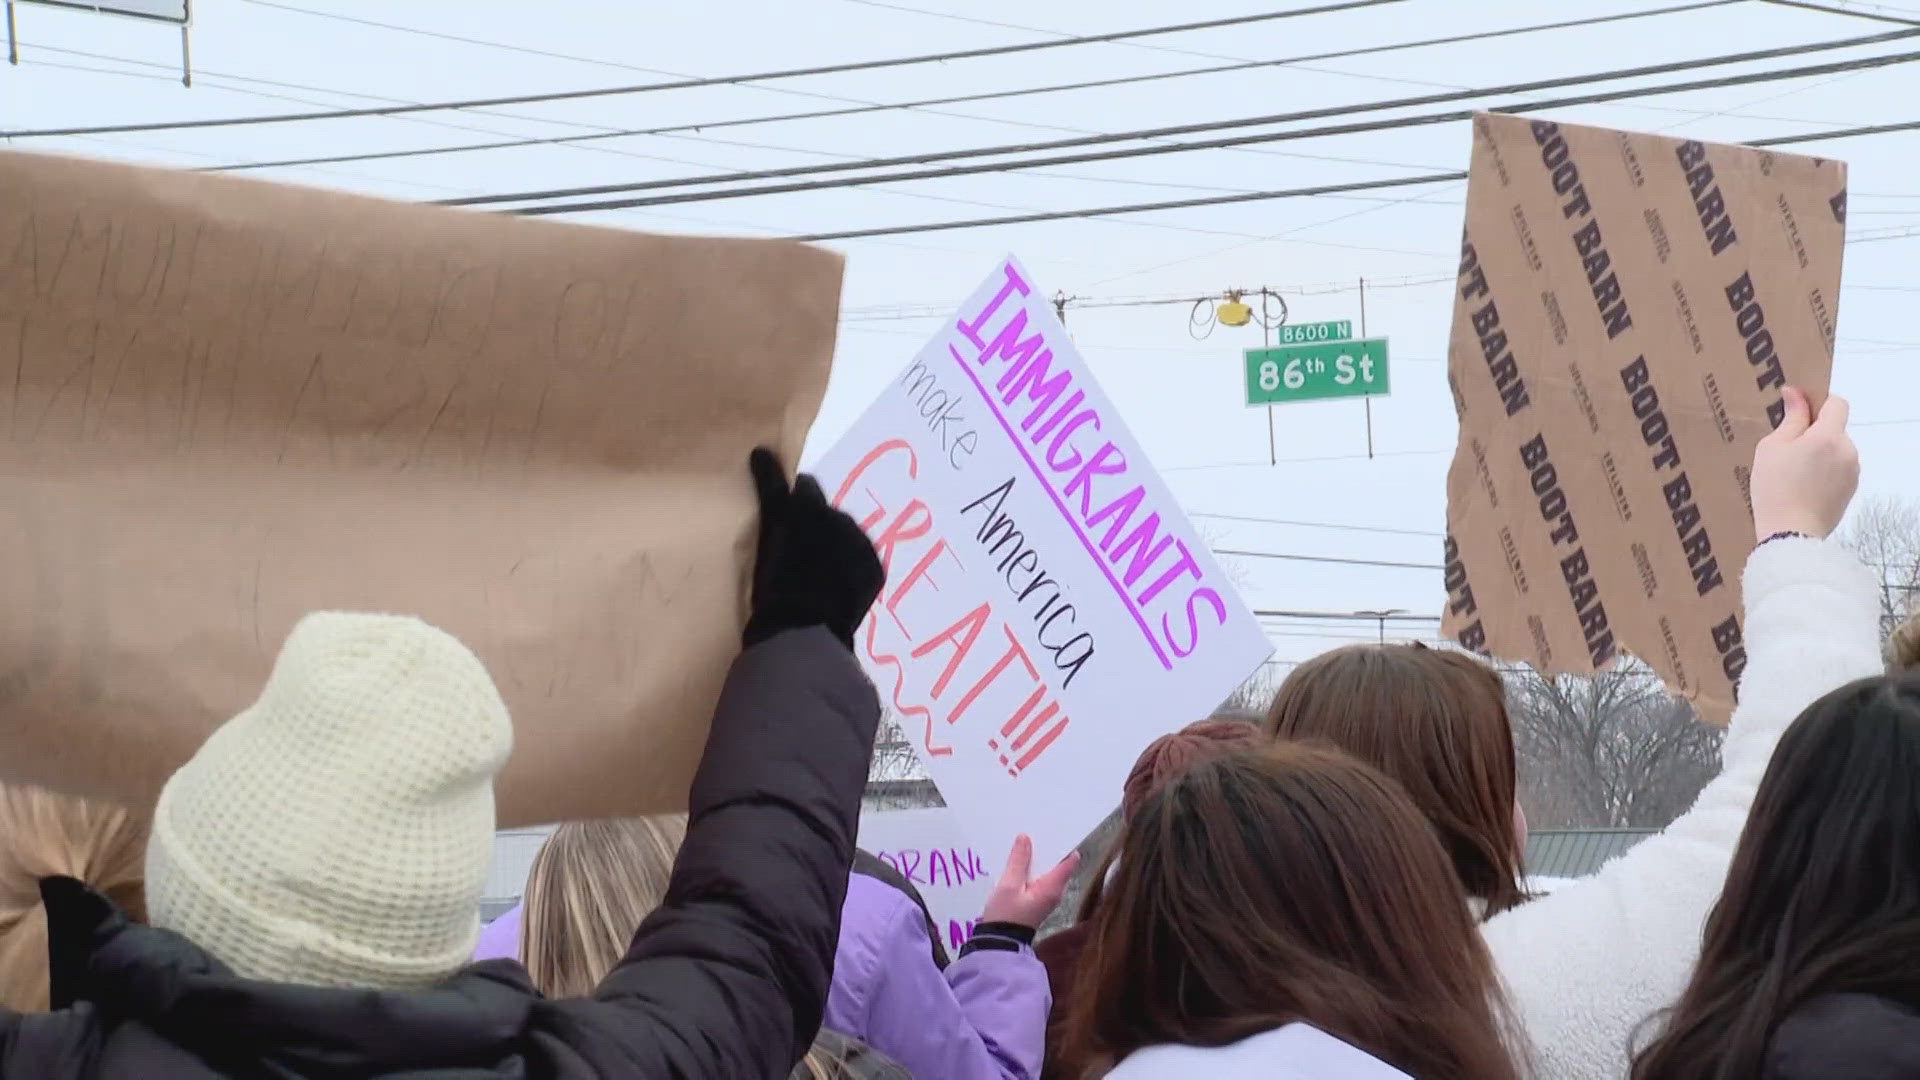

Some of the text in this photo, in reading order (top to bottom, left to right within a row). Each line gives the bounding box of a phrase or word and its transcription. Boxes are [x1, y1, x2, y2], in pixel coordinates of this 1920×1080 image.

[1531, 120, 1592, 219] BOOT
[1573, 218, 1633, 341] BARN
[1675, 140, 1737, 257] BARN
[1259, 353, 1375, 391] 86th St
[1283, 322, 1348, 343] 8600 N
[1472, 299, 1530, 418] BARN
[1725, 269, 1786, 392] BOOT
[900, 359, 978, 470] make
[957, 262, 1227, 658] IMMIGRANTS
[1620, 354, 1681, 471] BOOT
[1663, 471, 1724, 597] BARN
[832, 438, 1070, 778] GREAT!!!
[961, 477, 1095, 690] America
[1520, 431, 1579, 546] BOOT
[1560, 545, 1617, 669] BARN
[1711, 614, 1748, 703] BO
